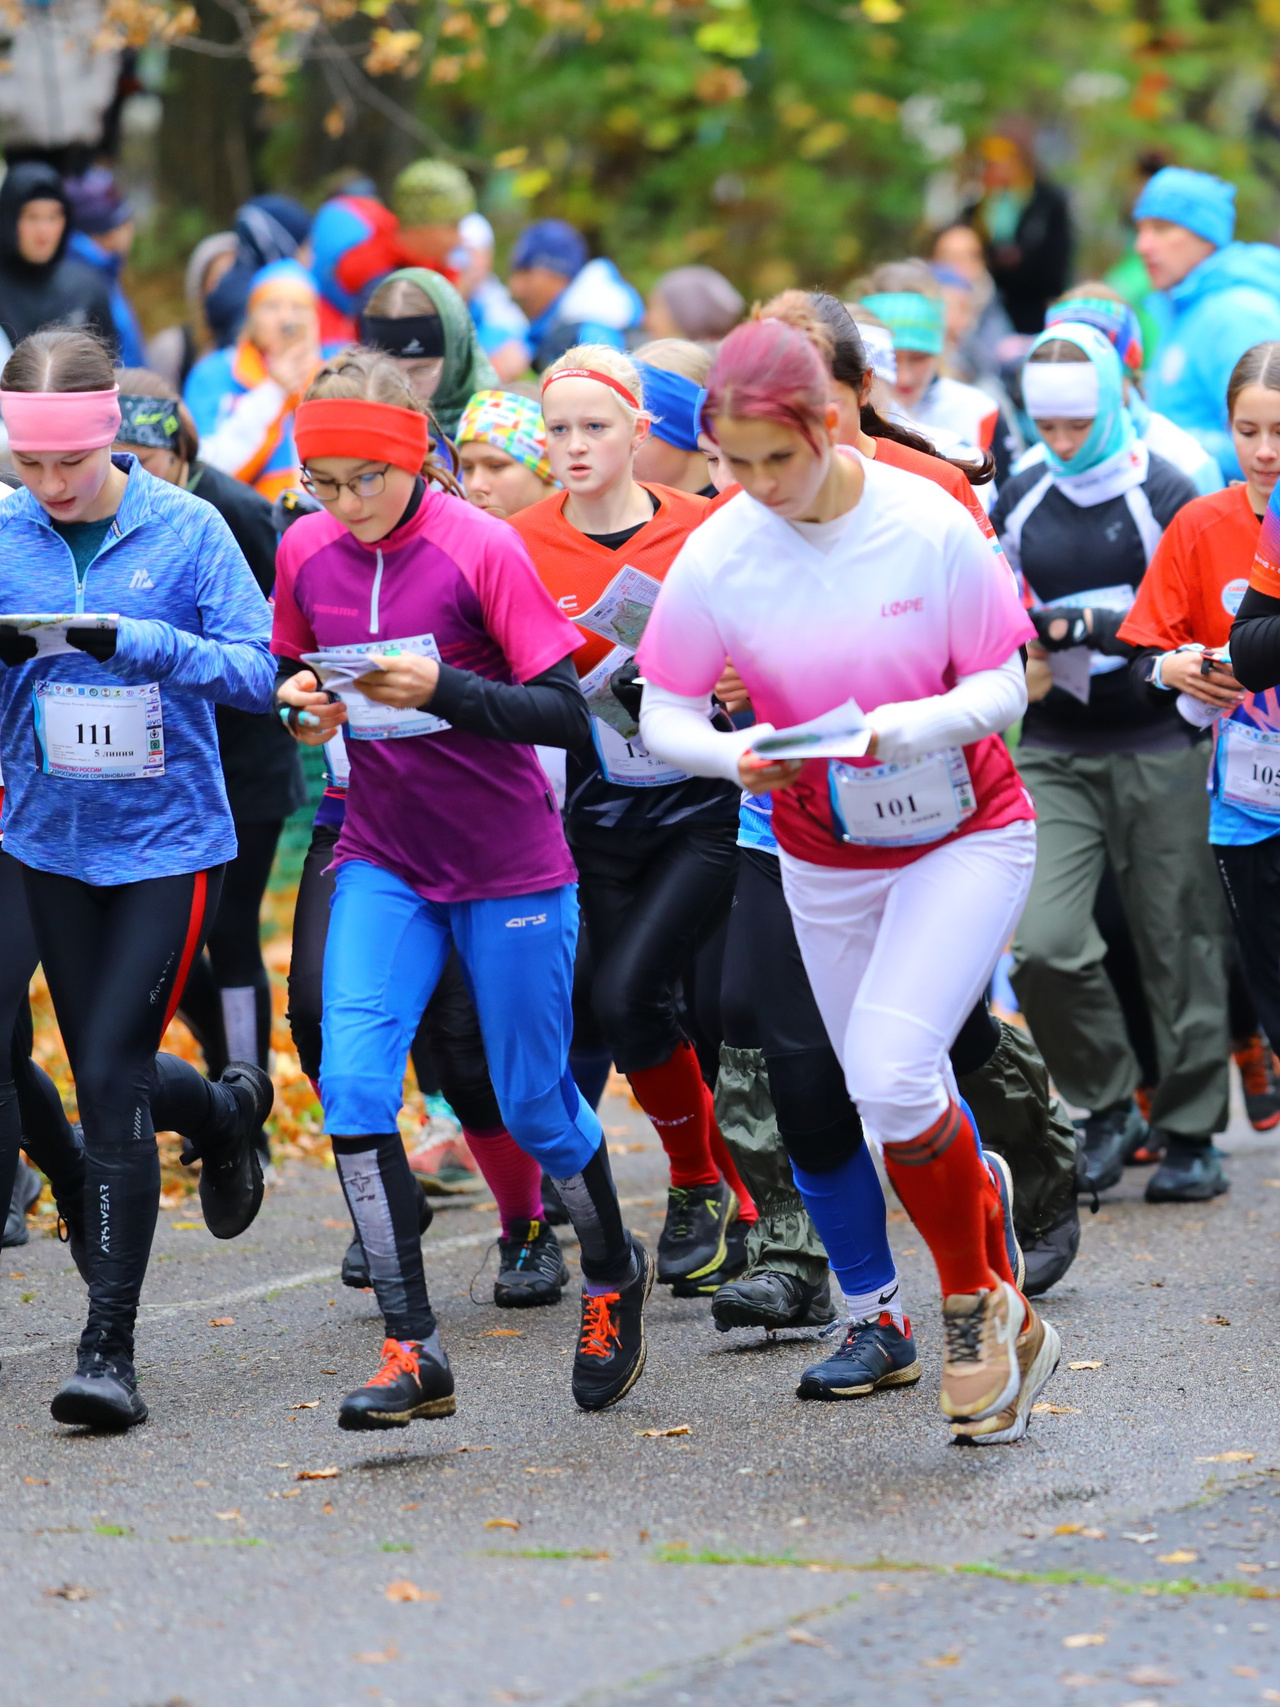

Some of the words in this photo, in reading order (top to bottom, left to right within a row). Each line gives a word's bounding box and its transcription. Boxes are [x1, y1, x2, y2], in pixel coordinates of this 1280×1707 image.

[76, 723, 112, 745] 111
[94, 750, 100, 758] 5
[102, 750, 134, 758] линия
[49, 762, 78, 772] ПЕРВЕНСТВО
[80, 764, 102, 773] РОССИИ
[875, 794, 918, 819] 101
